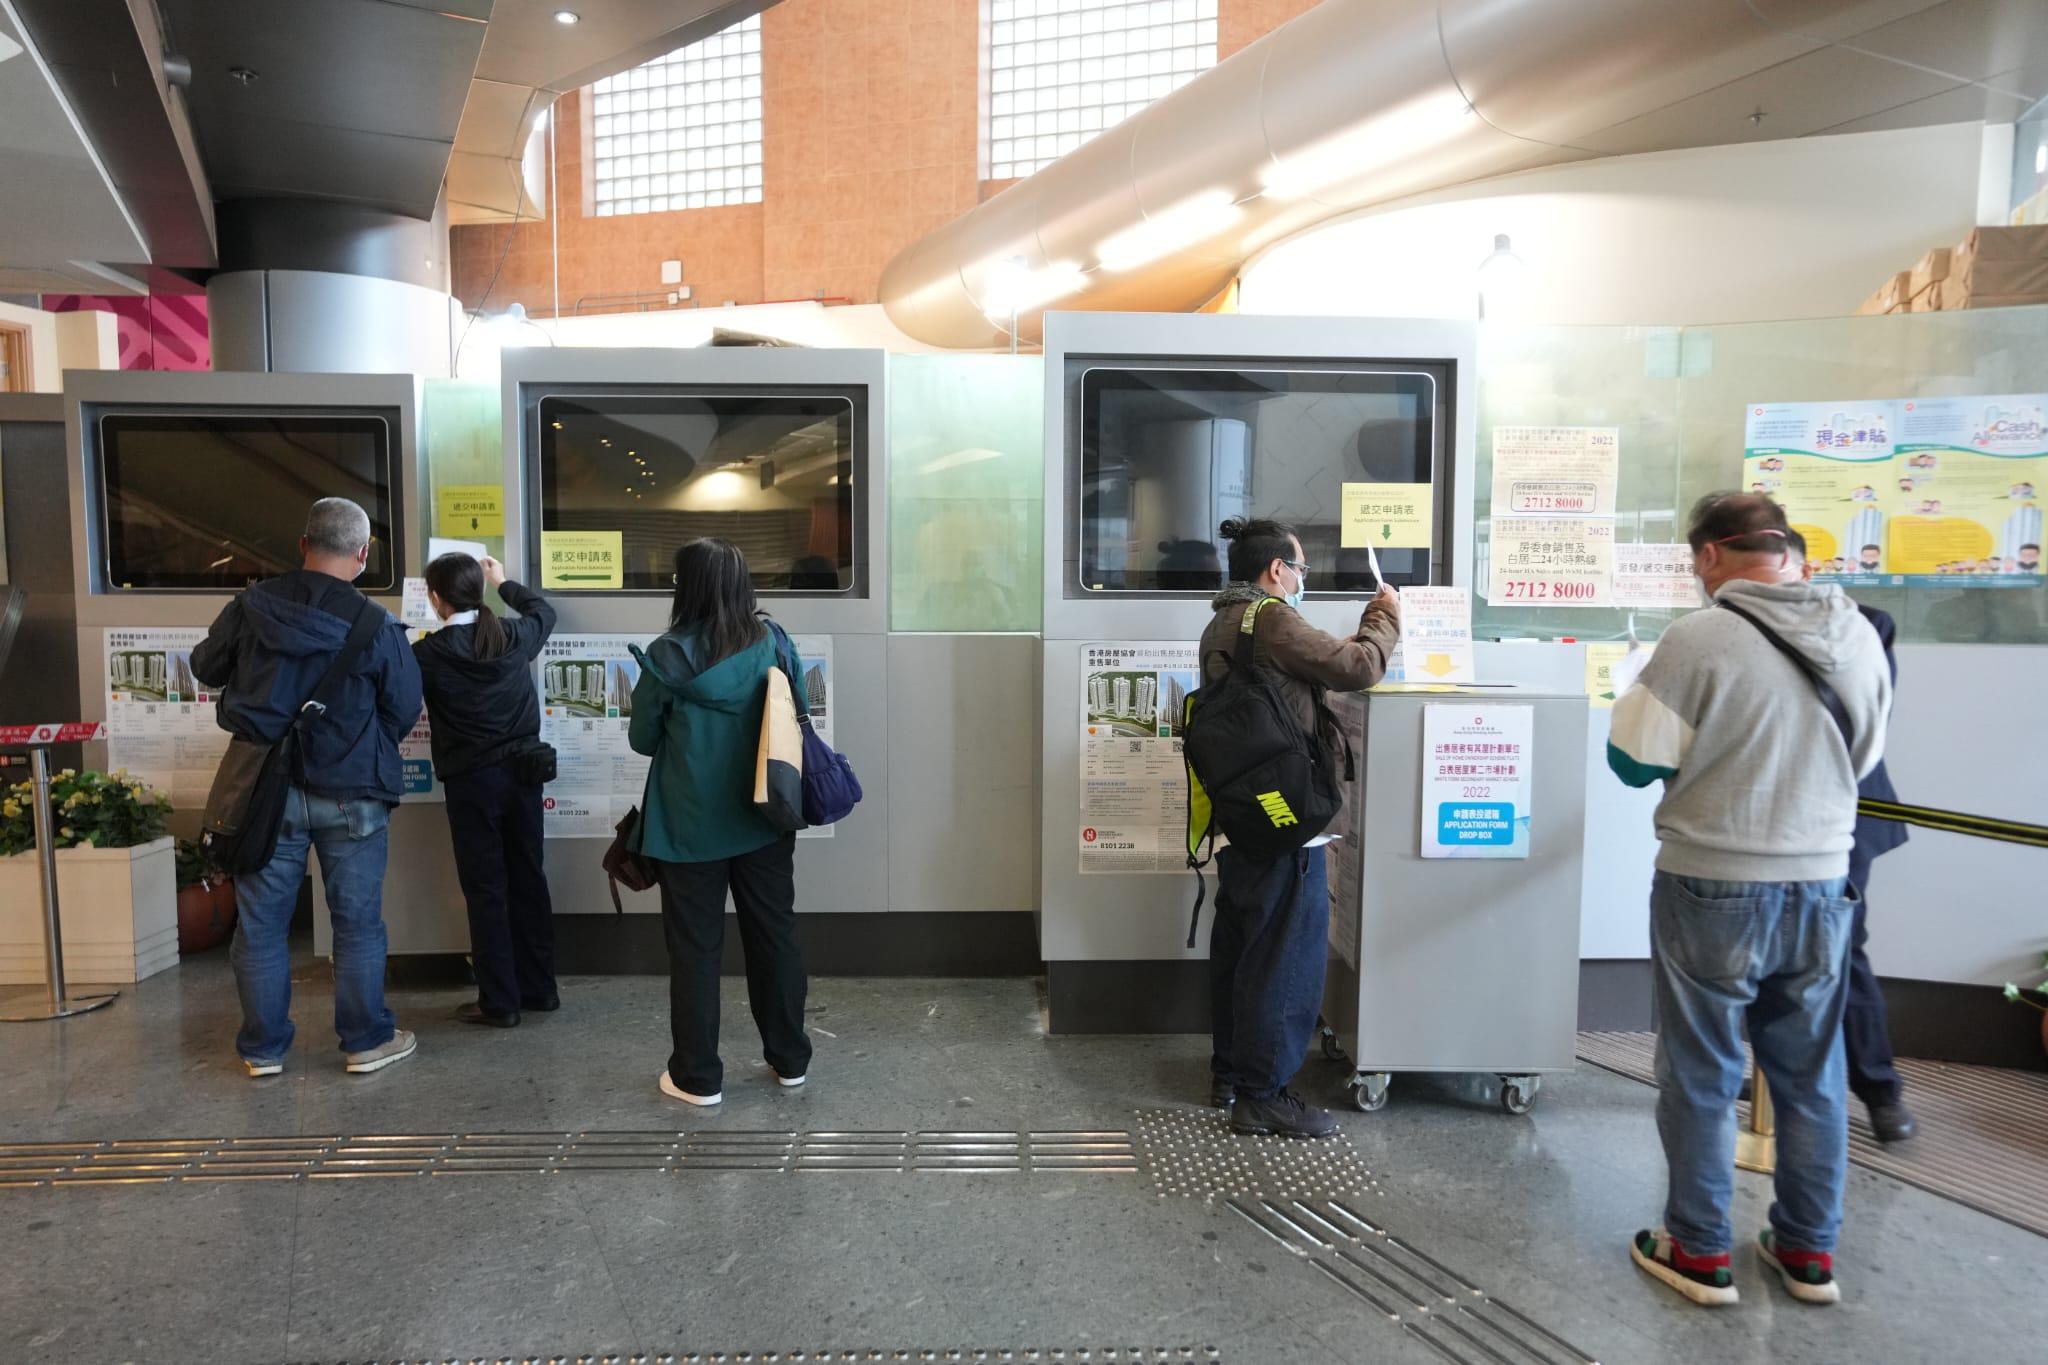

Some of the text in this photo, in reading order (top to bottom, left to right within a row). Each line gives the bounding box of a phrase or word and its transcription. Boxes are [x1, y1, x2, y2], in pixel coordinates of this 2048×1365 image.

[1995, 420, 2039, 432] Cash
[1591, 436, 1613, 445] 2022
[1816, 428, 1885, 447] 現金津貼
[1525, 497, 1583, 508] 2712 8000
[1360, 504, 1414, 515] 遞交申請表
[1588, 527, 1609, 536] 2022
[1519, 542, 1586, 554] 房委會銷售及
[1508, 554, 1598, 565] 白居二24小時熱線
[1505, 582, 1596, 598] 2712 8000
[1436, 744, 1520, 754] 出售居者有其屋計劃單位
[1439, 765, 1515, 775] 白表居屋第二市場計劃
[1463, 786, 1491, 798] 2022
[1256, 790, 1299, 828] NIKE
[1444, 821, 1487, 829] APPLICATION
[1458, 831, 1493, 839] DROP BOX
